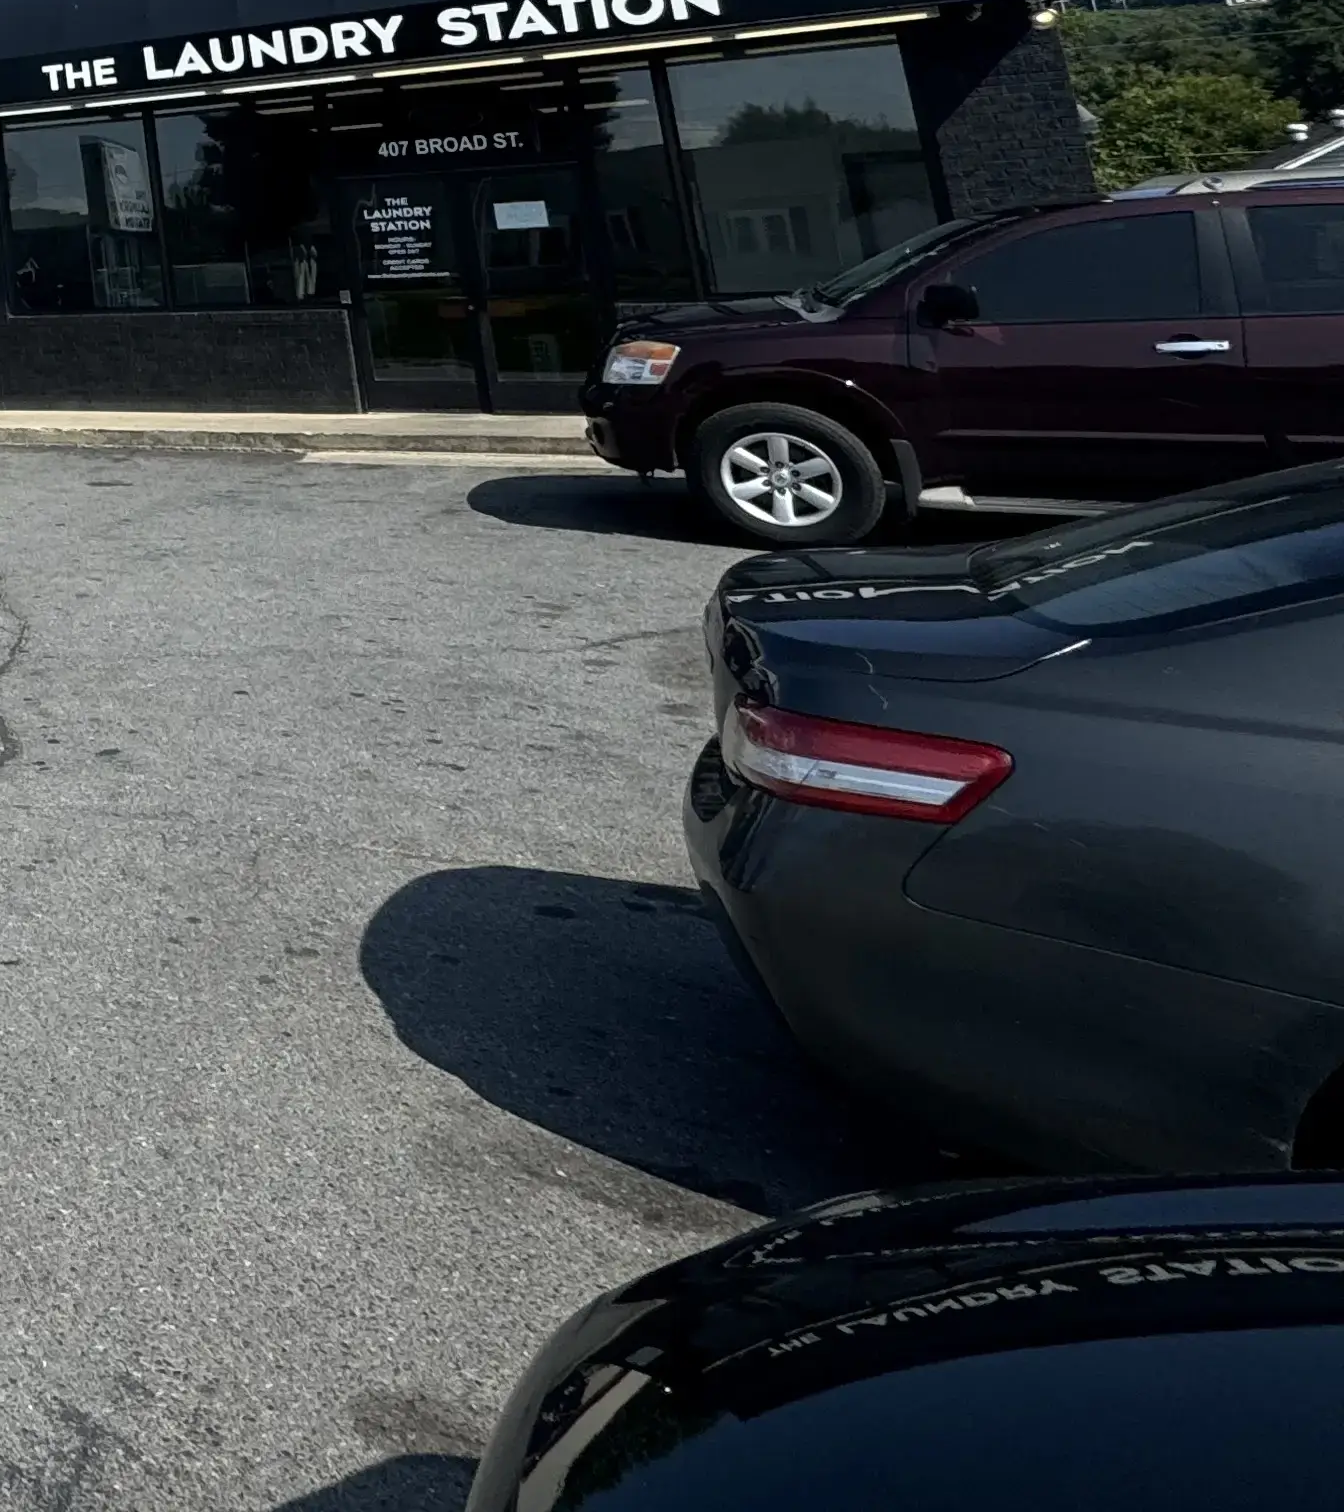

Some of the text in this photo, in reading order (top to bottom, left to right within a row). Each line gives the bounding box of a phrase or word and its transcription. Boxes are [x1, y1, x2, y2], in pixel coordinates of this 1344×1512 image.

[41, 56, 118, 92] THE
[143, 14, 404, 81] LAUNDRY
[378, 131, 524, 157] 407 BROAD ST.
[384, 197, 408, 206] THE
[363, 206, 433, 220] LAUNDRY
[370, 219, 432, 233] STATION
